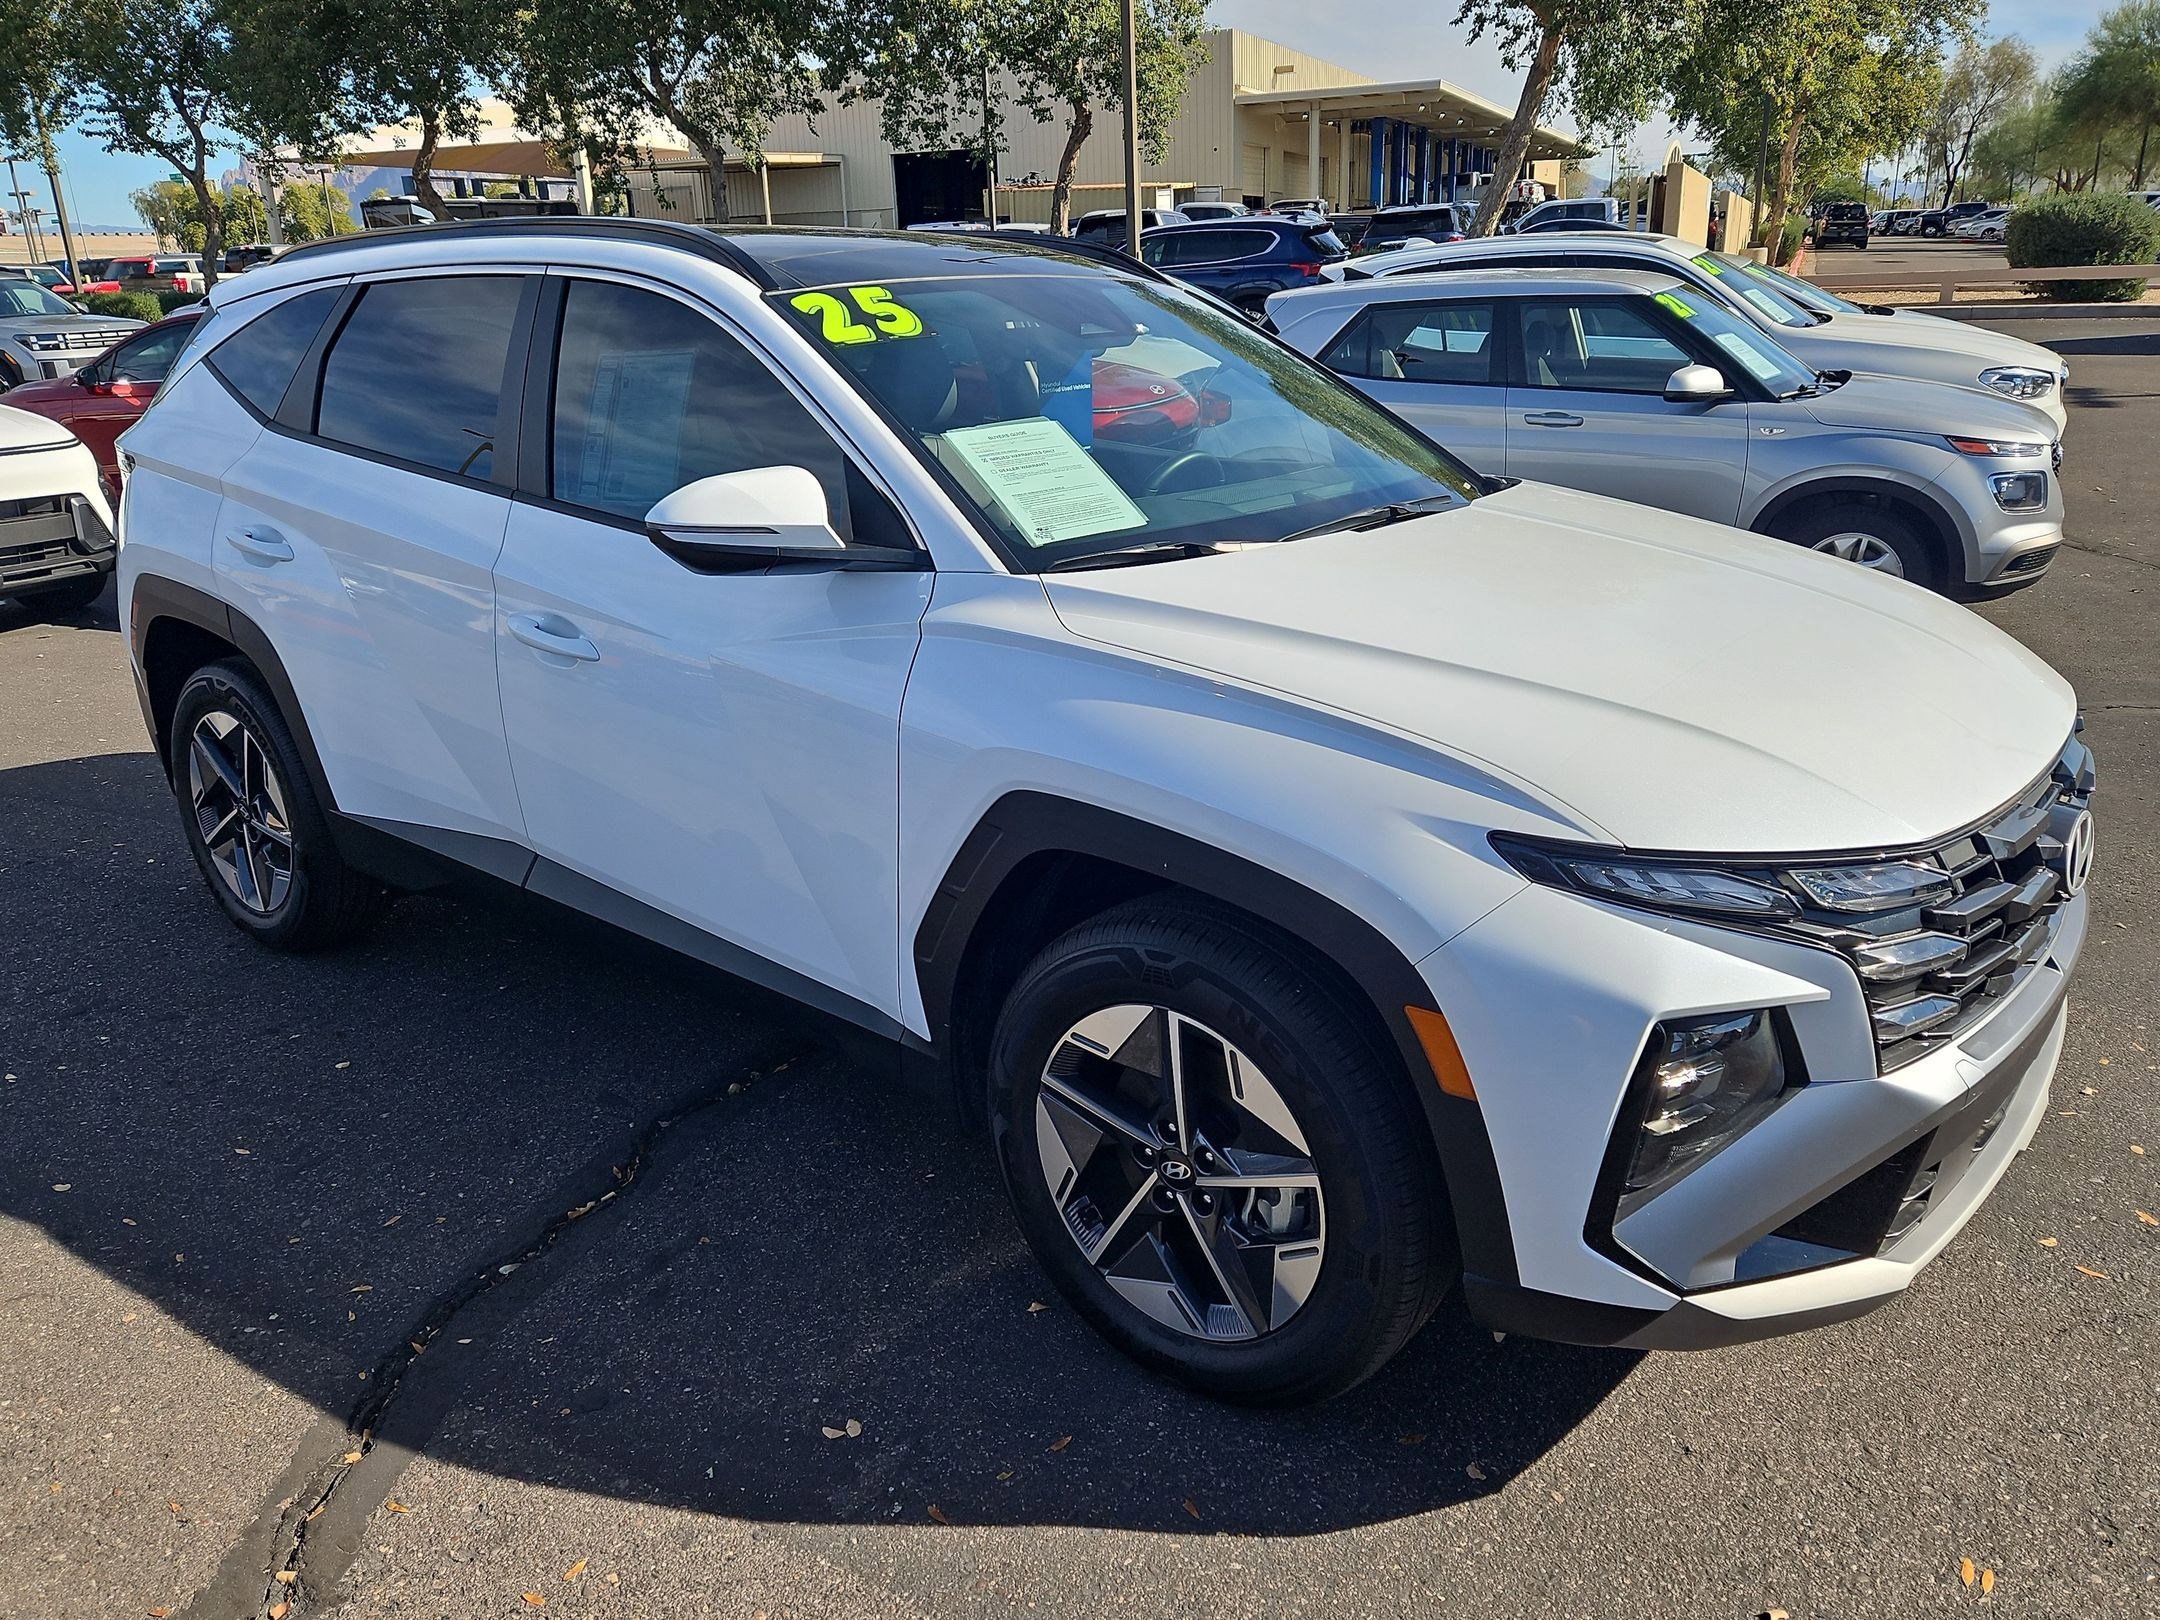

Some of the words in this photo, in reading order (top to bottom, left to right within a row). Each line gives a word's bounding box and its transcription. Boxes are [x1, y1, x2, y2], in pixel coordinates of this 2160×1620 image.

[790, 286, 923, 344] 25
[1061, 384, 1073, 392] Used
[1073, 383, 1091, 391] Vehicles
